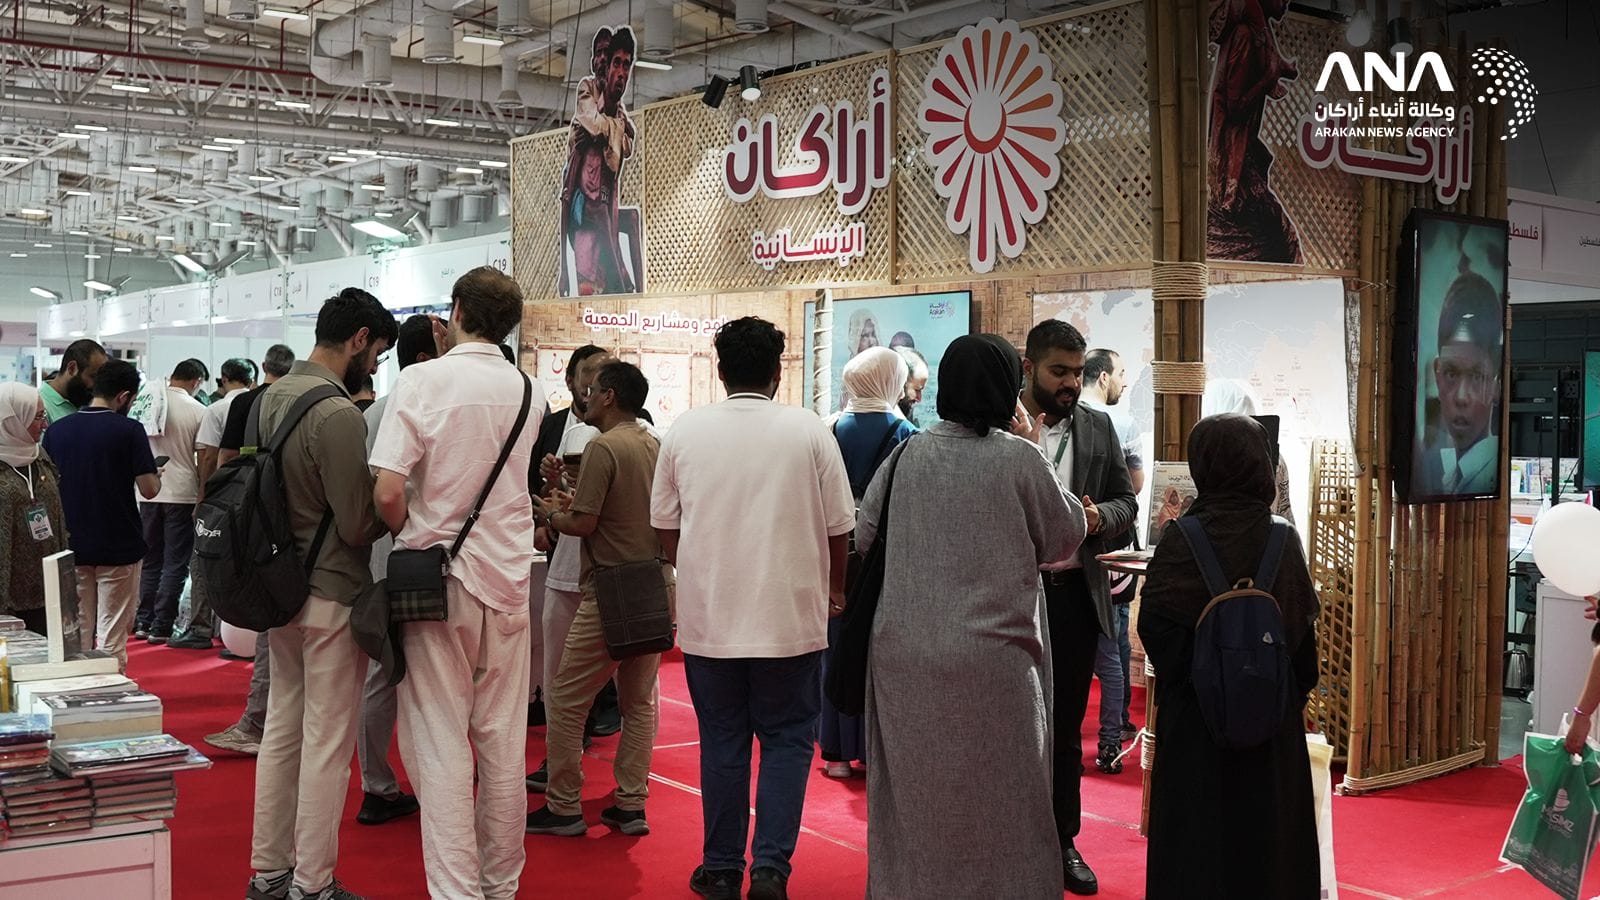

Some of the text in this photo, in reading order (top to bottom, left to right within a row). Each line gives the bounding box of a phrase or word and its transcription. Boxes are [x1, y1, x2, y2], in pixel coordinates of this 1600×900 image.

[724, 74, 888, 208] أراكان
[752, 225, 864, 267] الإنسانية
[584, 308, 638, 331] الجمعية
[642, 311, 699, 335] ومشاريع
